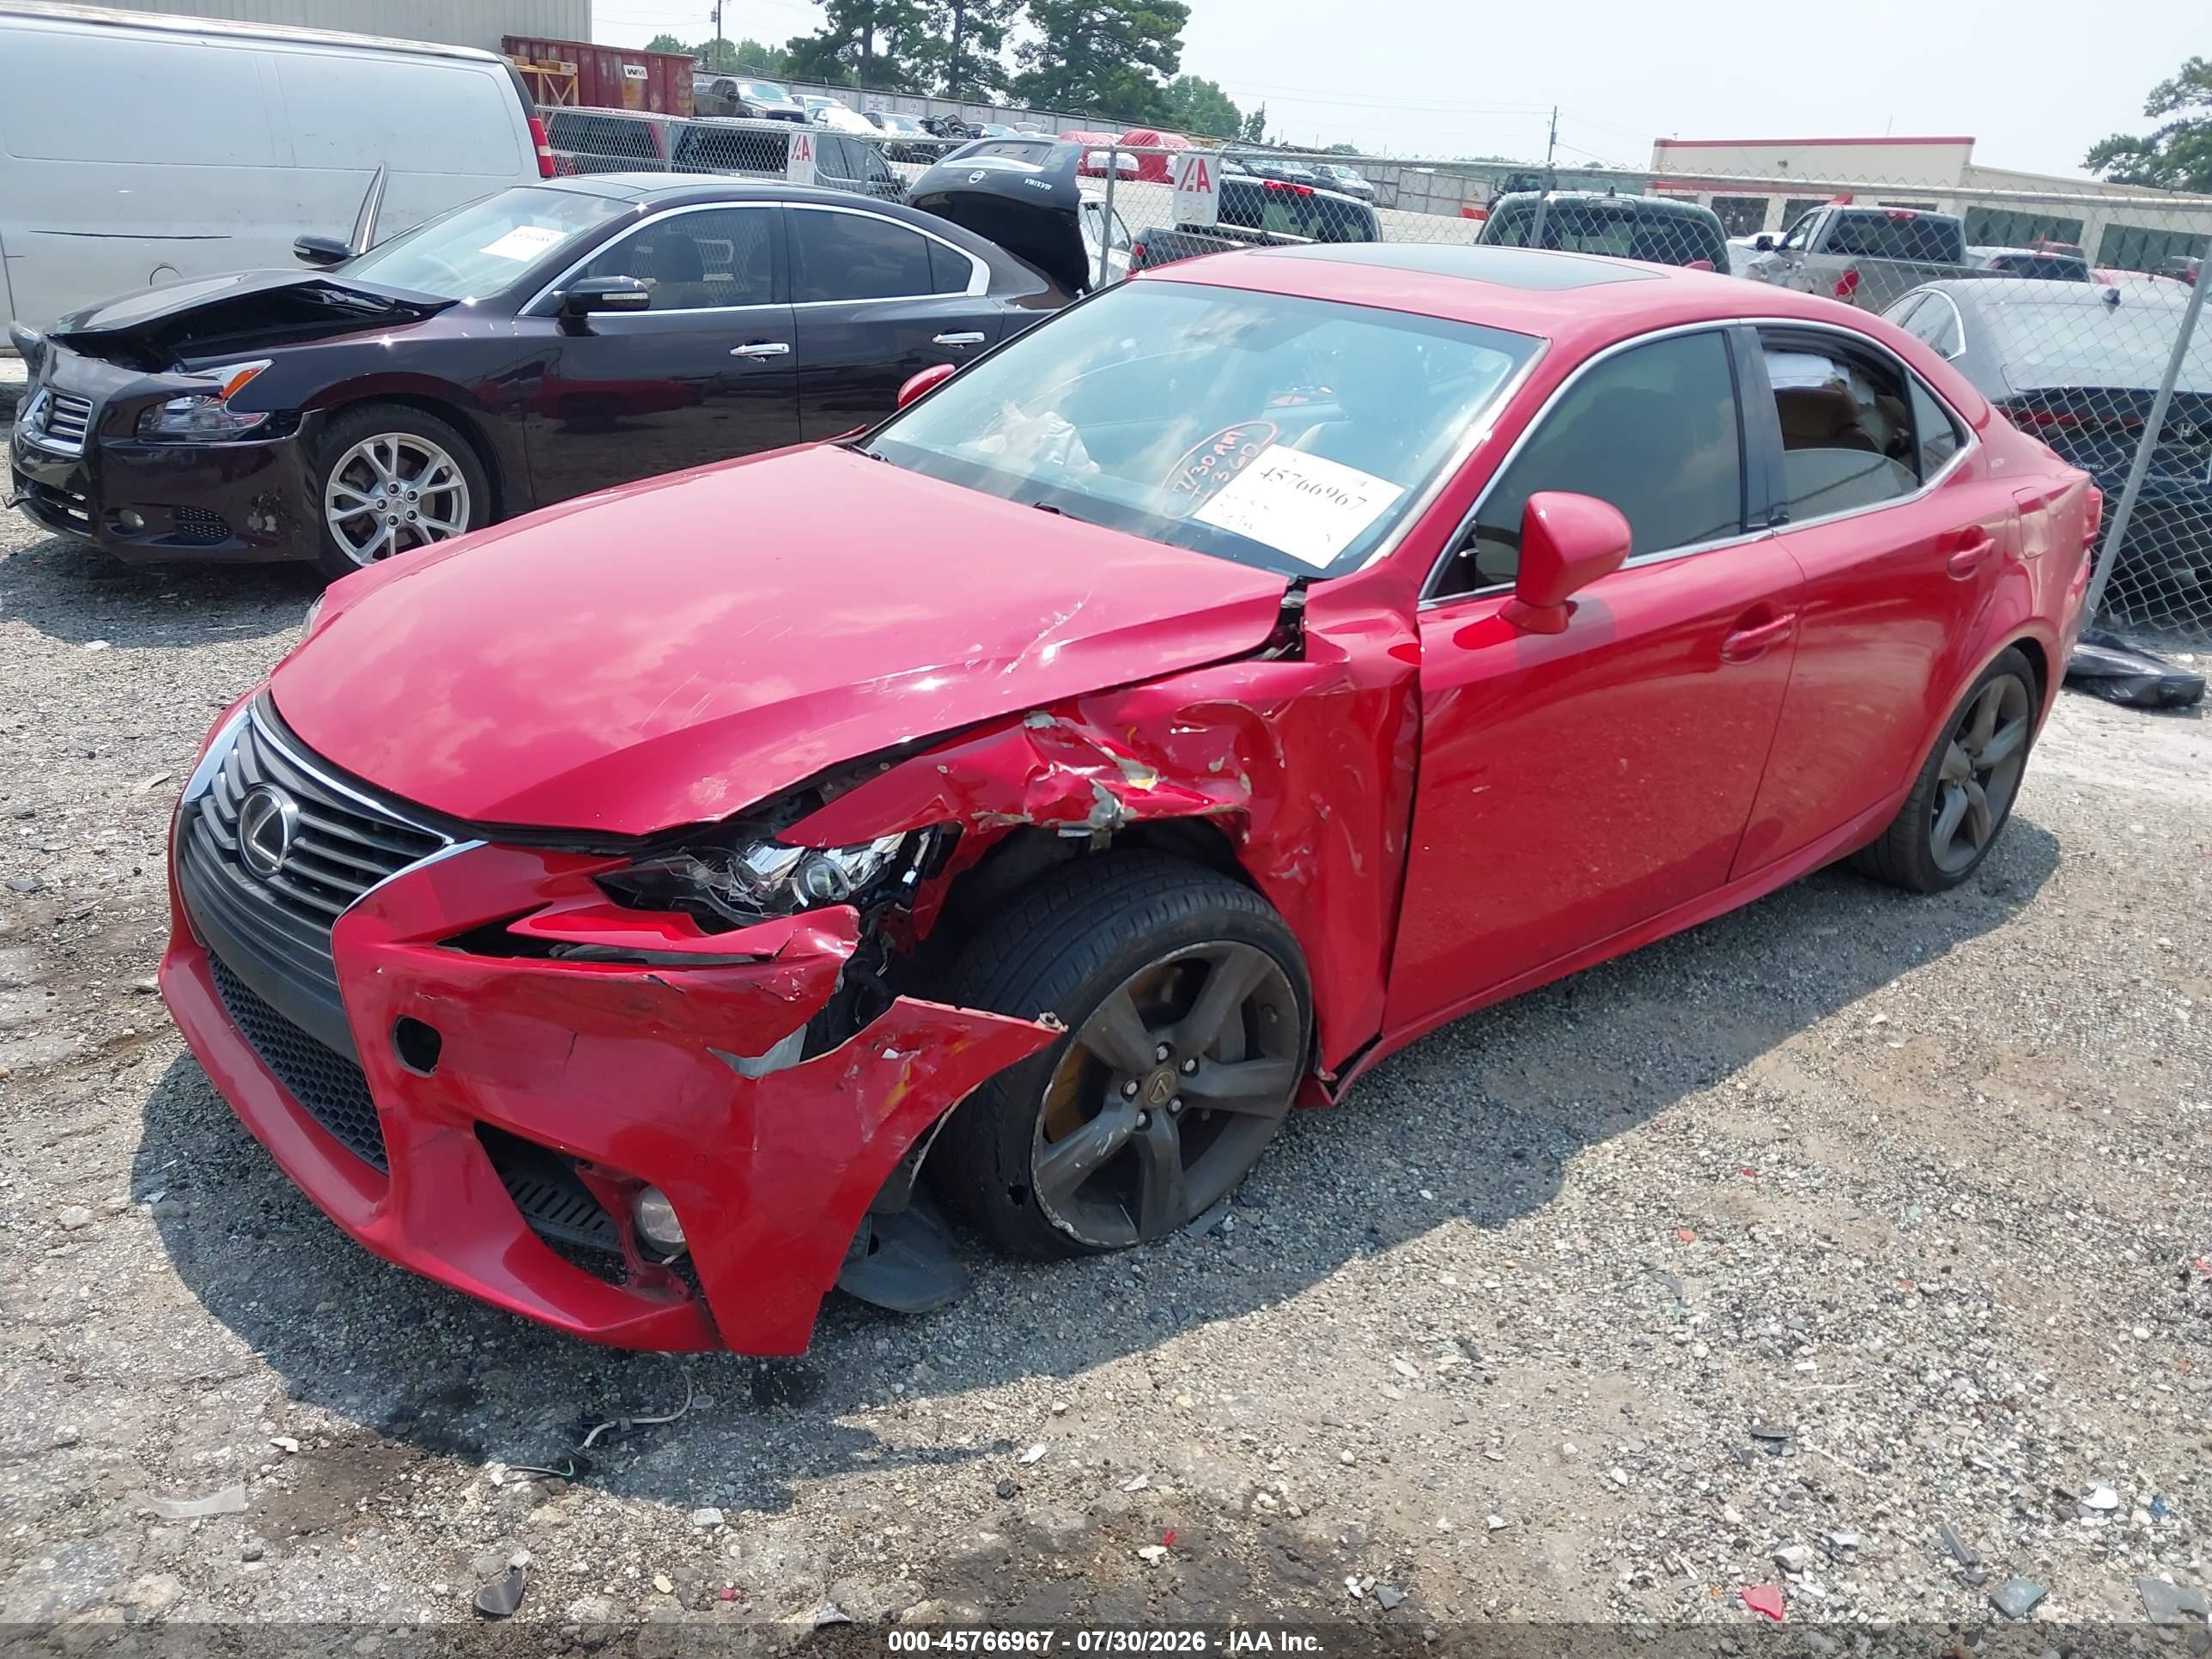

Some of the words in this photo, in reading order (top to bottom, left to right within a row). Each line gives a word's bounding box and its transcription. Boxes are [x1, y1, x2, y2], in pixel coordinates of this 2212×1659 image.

[627, 68, 646, 76] WM
[1024, 178, 1053, 191] MAXIMA
[1259, 466, 1368, 511] 45766967
